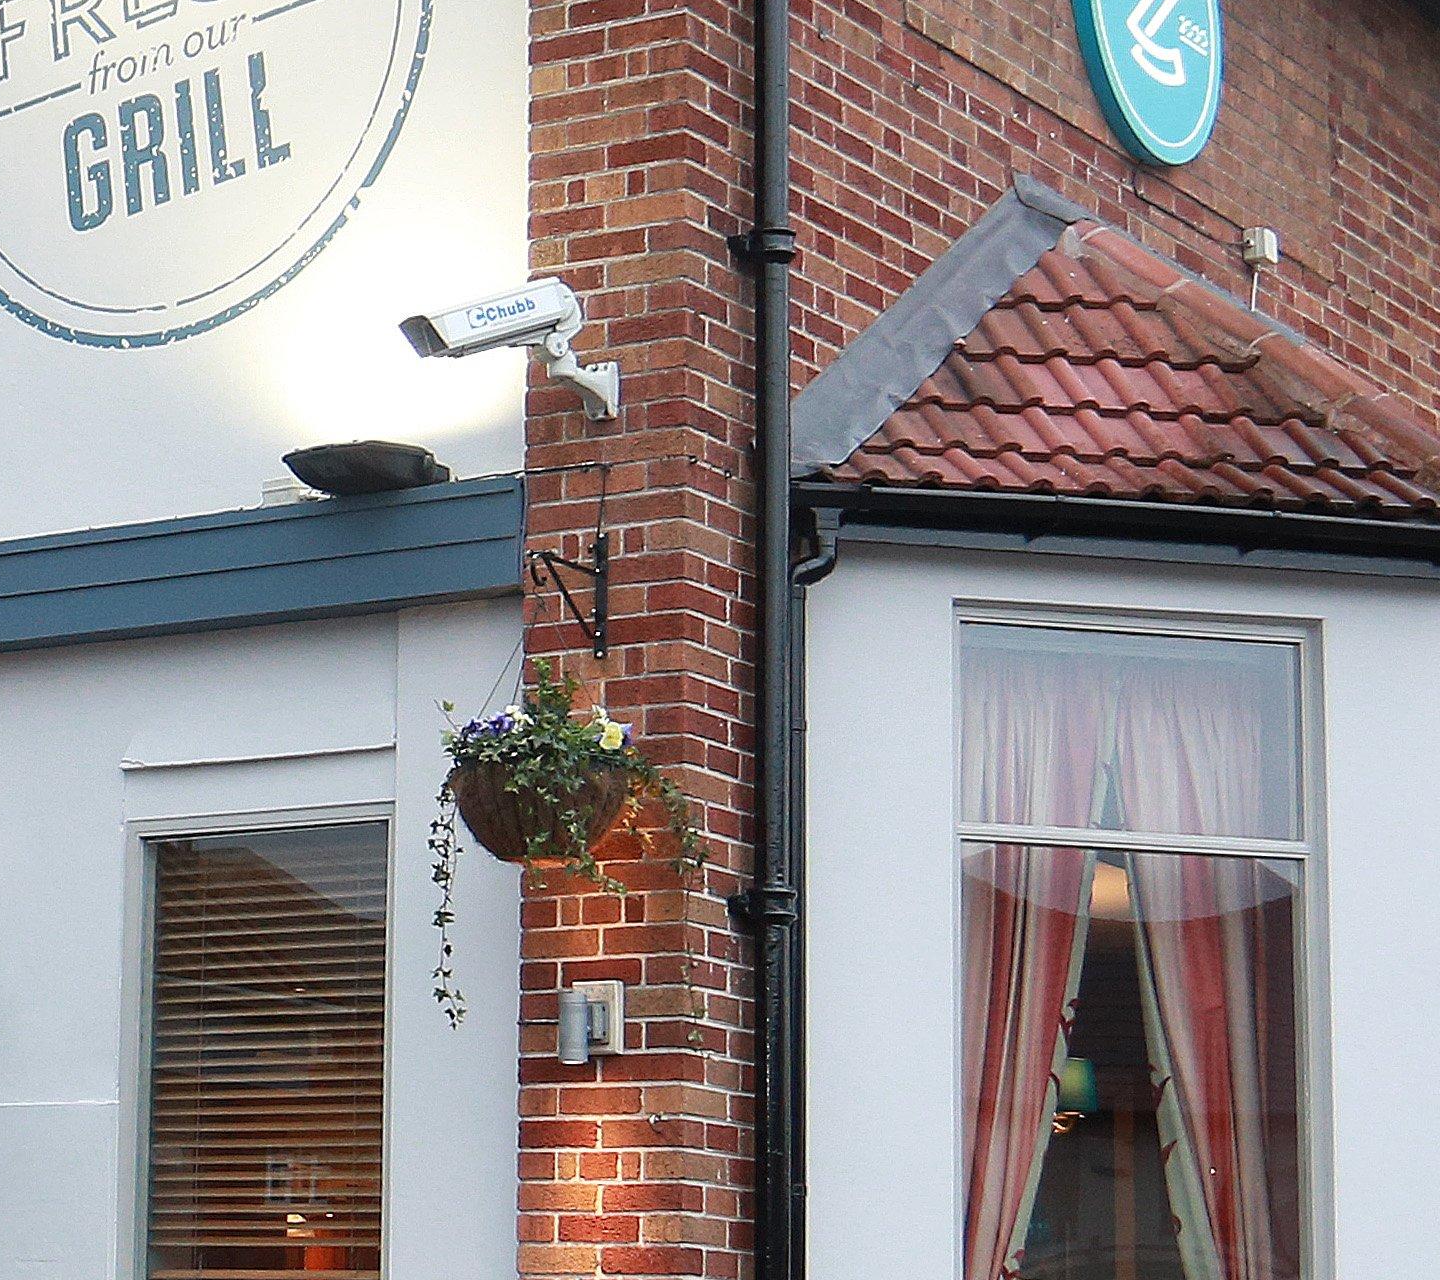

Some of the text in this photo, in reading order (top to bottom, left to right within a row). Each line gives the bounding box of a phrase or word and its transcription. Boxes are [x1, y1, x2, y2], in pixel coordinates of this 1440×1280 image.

[88, 13, 247, 95] from our
[62, 51, 291, 232] GRILL
[486, 297, 536, 321] Chubb
